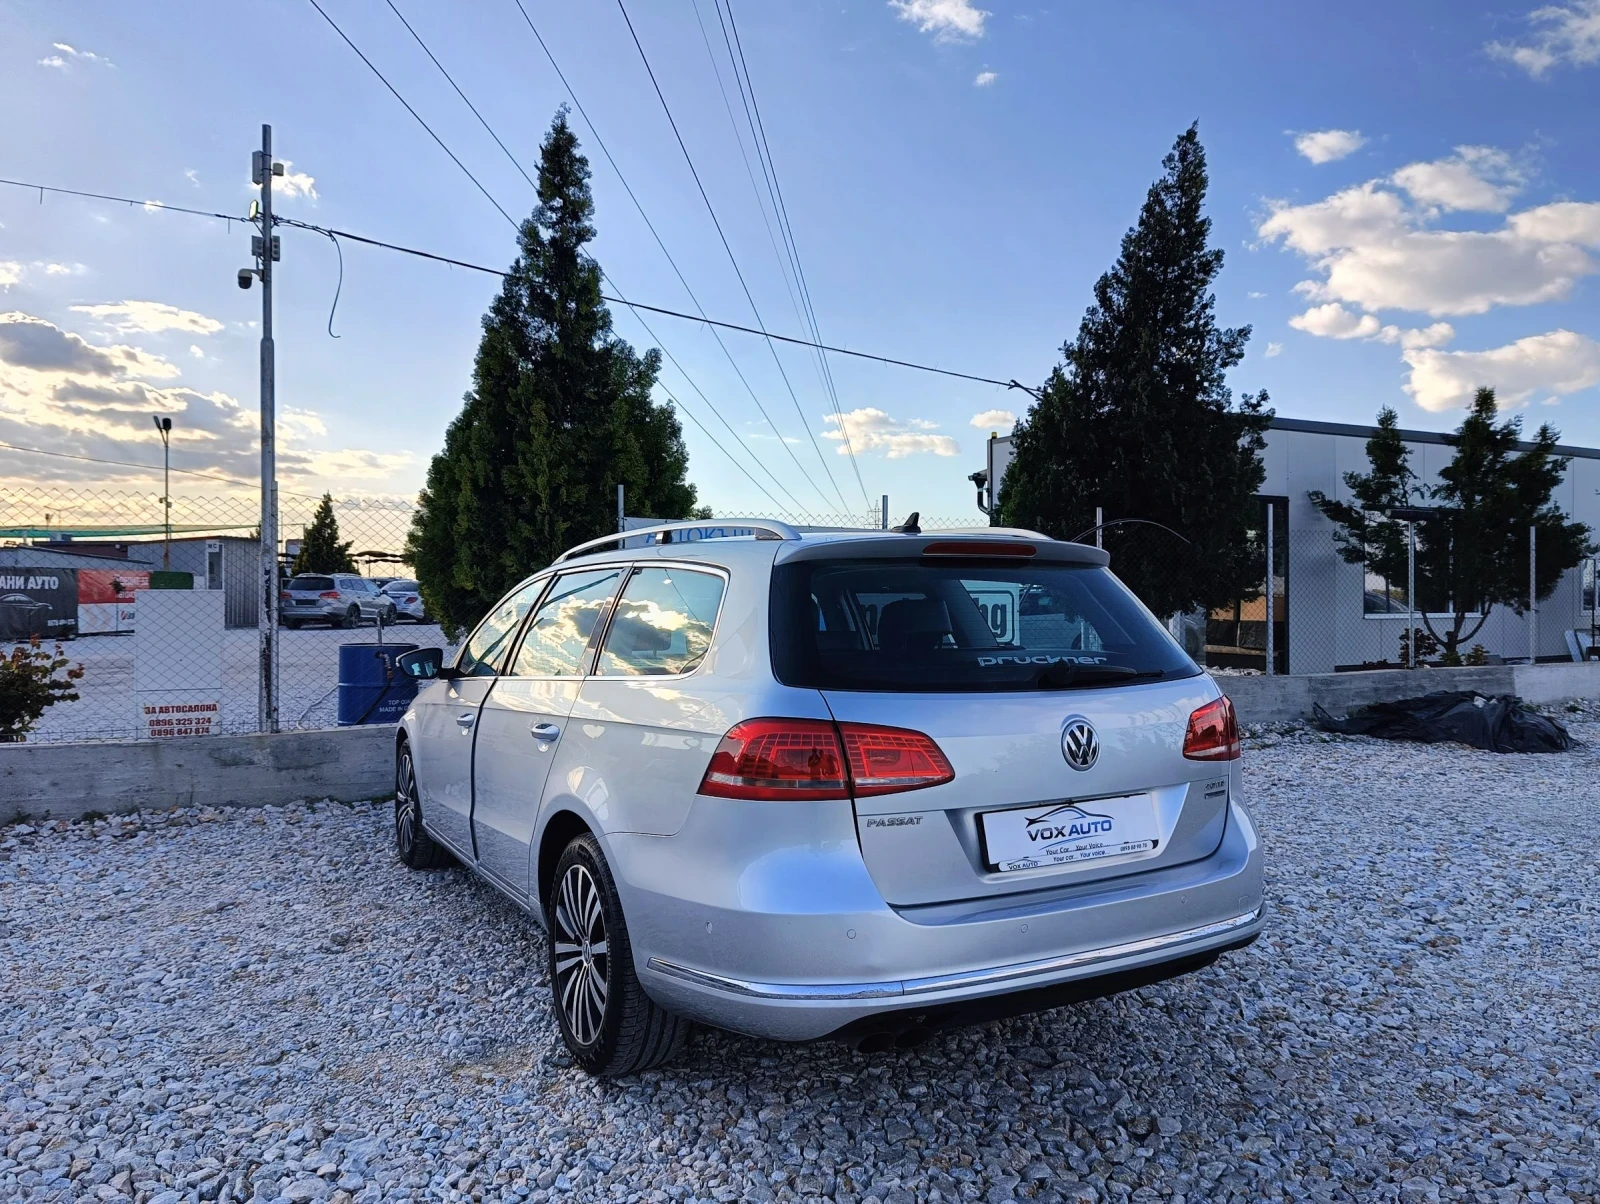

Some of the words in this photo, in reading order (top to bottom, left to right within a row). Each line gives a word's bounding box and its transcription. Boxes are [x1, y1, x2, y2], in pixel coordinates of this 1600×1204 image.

[27, 575, 60, 590] АУТО
[144, 706, 157, 715] ЗА
[158, 703, 218, 714] АВТОСАЛОНА
[149, 718, 174, 727] 0896
[175, 717, 193, 726] 325
[194, 716, 212, 725] 324
[150, 728, 175, 737] 0896
[176, 727, 193, 736] 847
[194, 726, 210, 735] 874
[866, 816, 924, 828] PASSAT
[1026, 825, 1067, 842] VOX
[1068, 819, 1112, 837] AUTO
